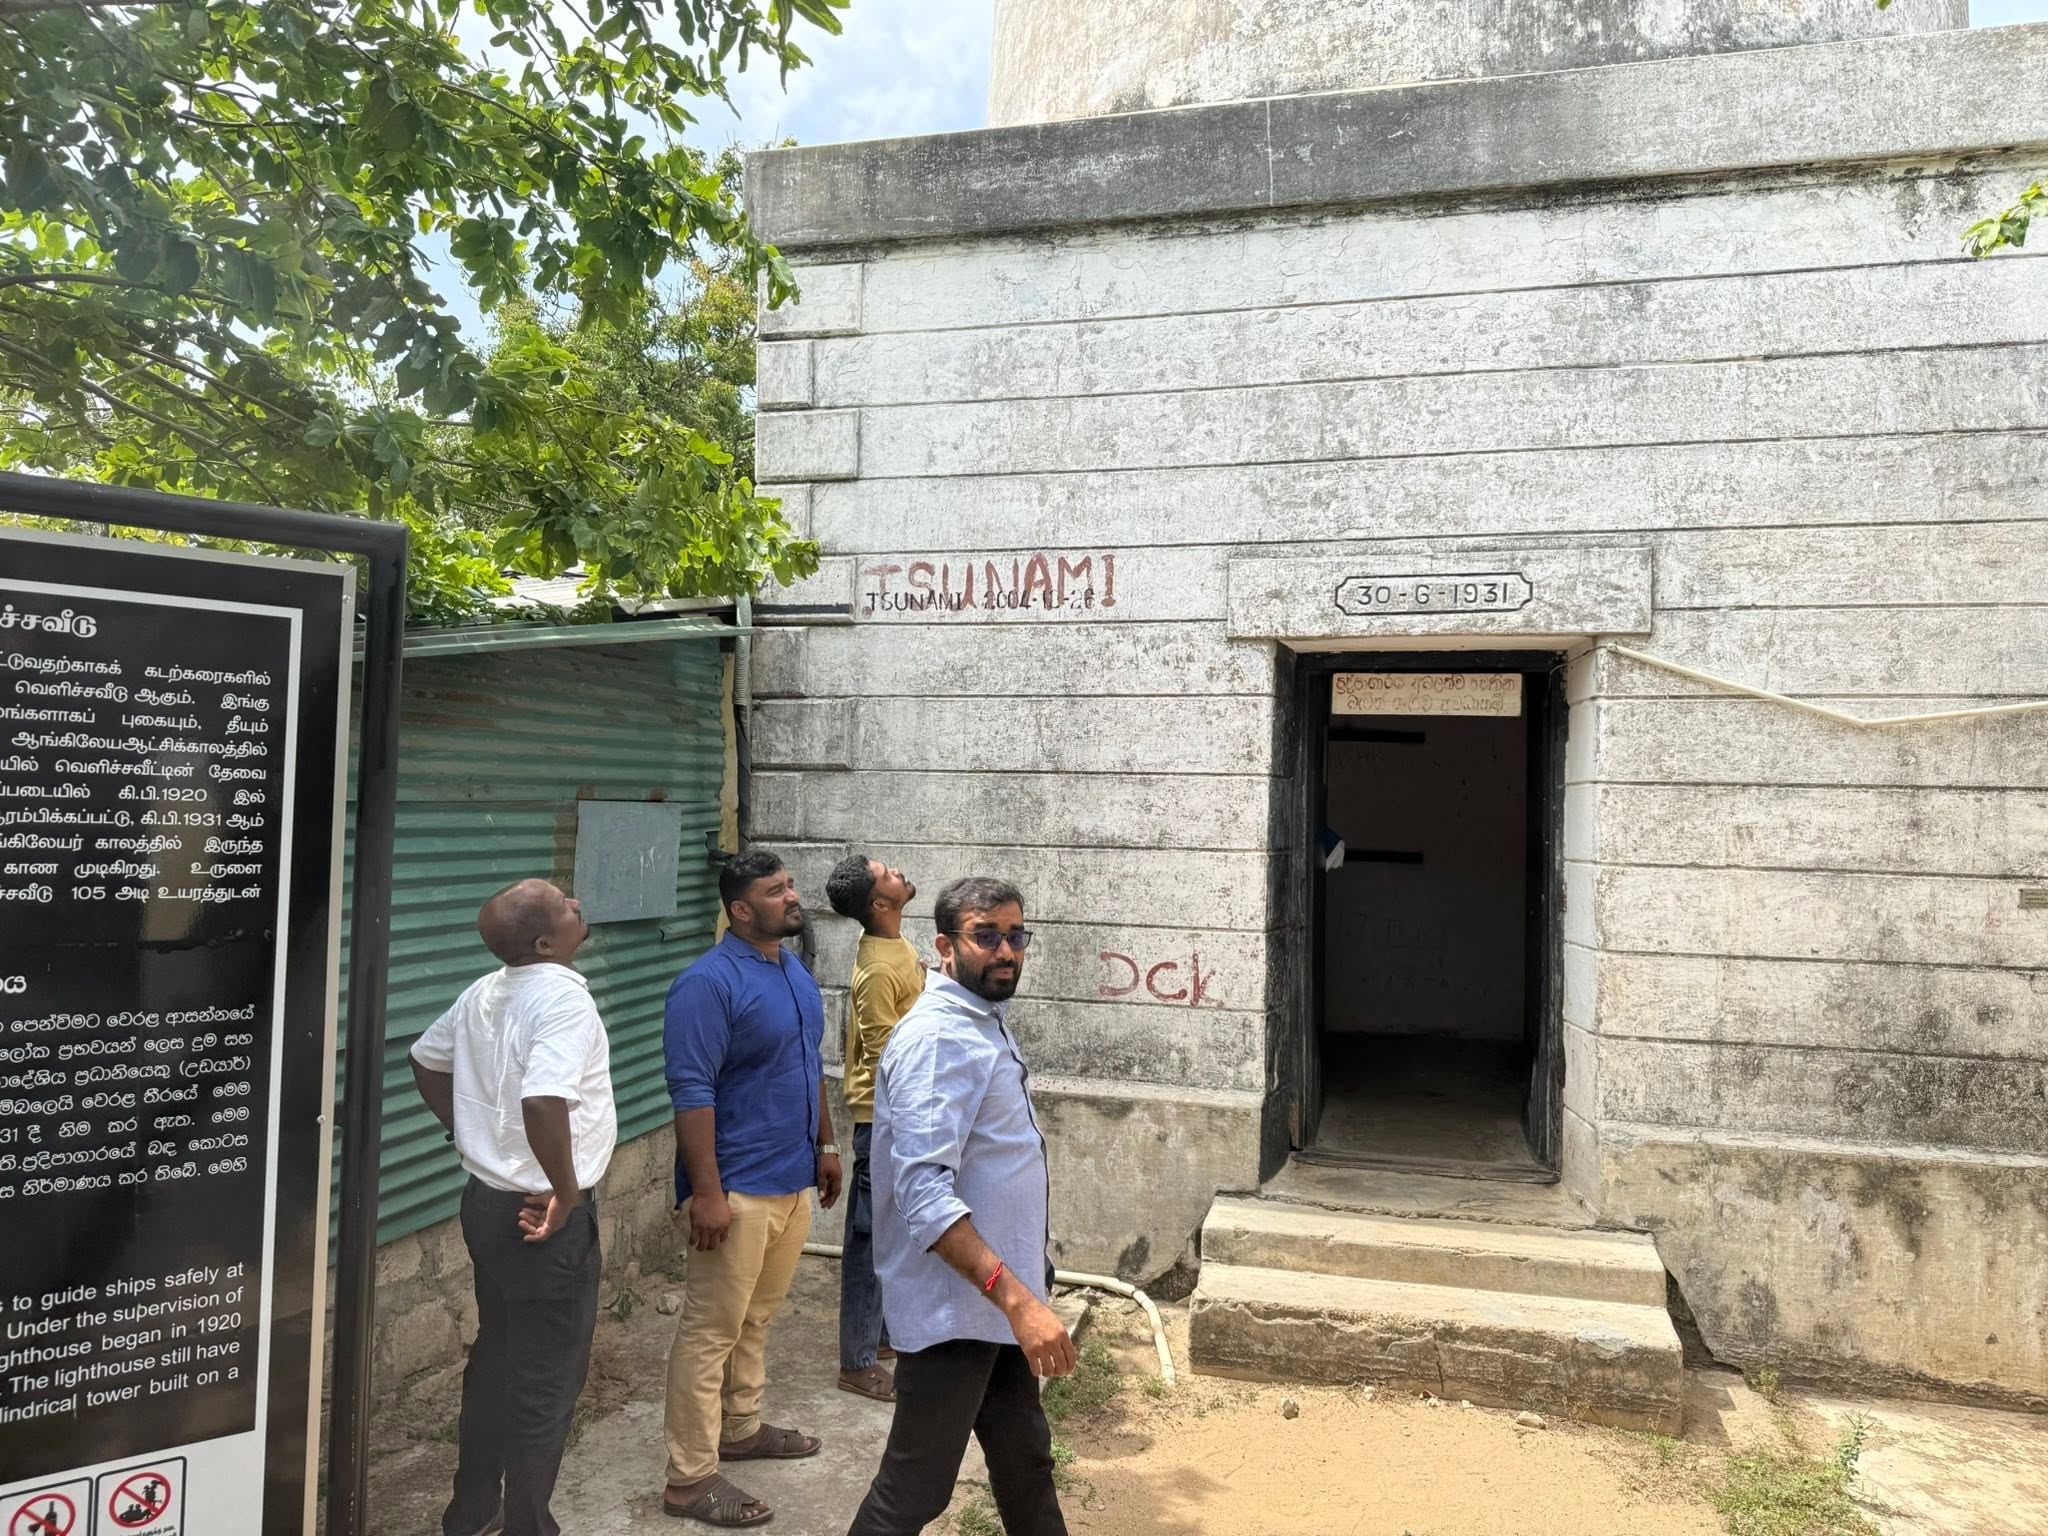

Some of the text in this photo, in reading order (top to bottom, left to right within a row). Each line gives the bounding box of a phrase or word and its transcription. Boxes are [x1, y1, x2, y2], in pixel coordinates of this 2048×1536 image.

[864, 552, 1116, 609] TSUNAMI
[145, 664, 270, 685] கடற்கரைகளில்
[16, 680, 269, 711] வெளிச்சவீடு ஆகும். இங்கு
[225, 715, 268, 735] தீயும்
[55, 759, 195, 780] வெளிச்சவீட்டின்
[209, 764, 266, 783] தேவை
[233, 789, 265, 805] இல்
[226, 813, 264, 830] ஆம்
[95, 835, 182, 854] காலத்தில்
[204, 836, 263, 855] இருந்த
[4, 863, 58, 874] காண
[191, 862, 262, 878] உருளை
[72, 887, 105, 899] 105
[115, 886, 150, 903] அடி
[144, 1038, 184, 1053] ලෙස
[213, 1082, 250, 1097] මෙම
[212, 1107, 249, 1123] මෙම
[13, 1296, 31, 1311] to
[41, 1285, 96, 1310] guide
[106, 1278, 156, 1296] ships
[165, 1266, 219, 1287] safely
[226, 1262, 243, 1278] at
[8, 1286, 244, 1339] Under the supervision of
[102, 1330, 161, 1350] began
[172, 1323, 186, 1338] in
[198, 1312, 241, 1333] 1920
[9, 1342, 240, 1393] The lighthouse still have
[87, 1385, 141, 1406] tower
[150, 1374, 188, 1394] built
[197, 1371, 218, 1385] on
[228, 1367, 238, 1379] a
